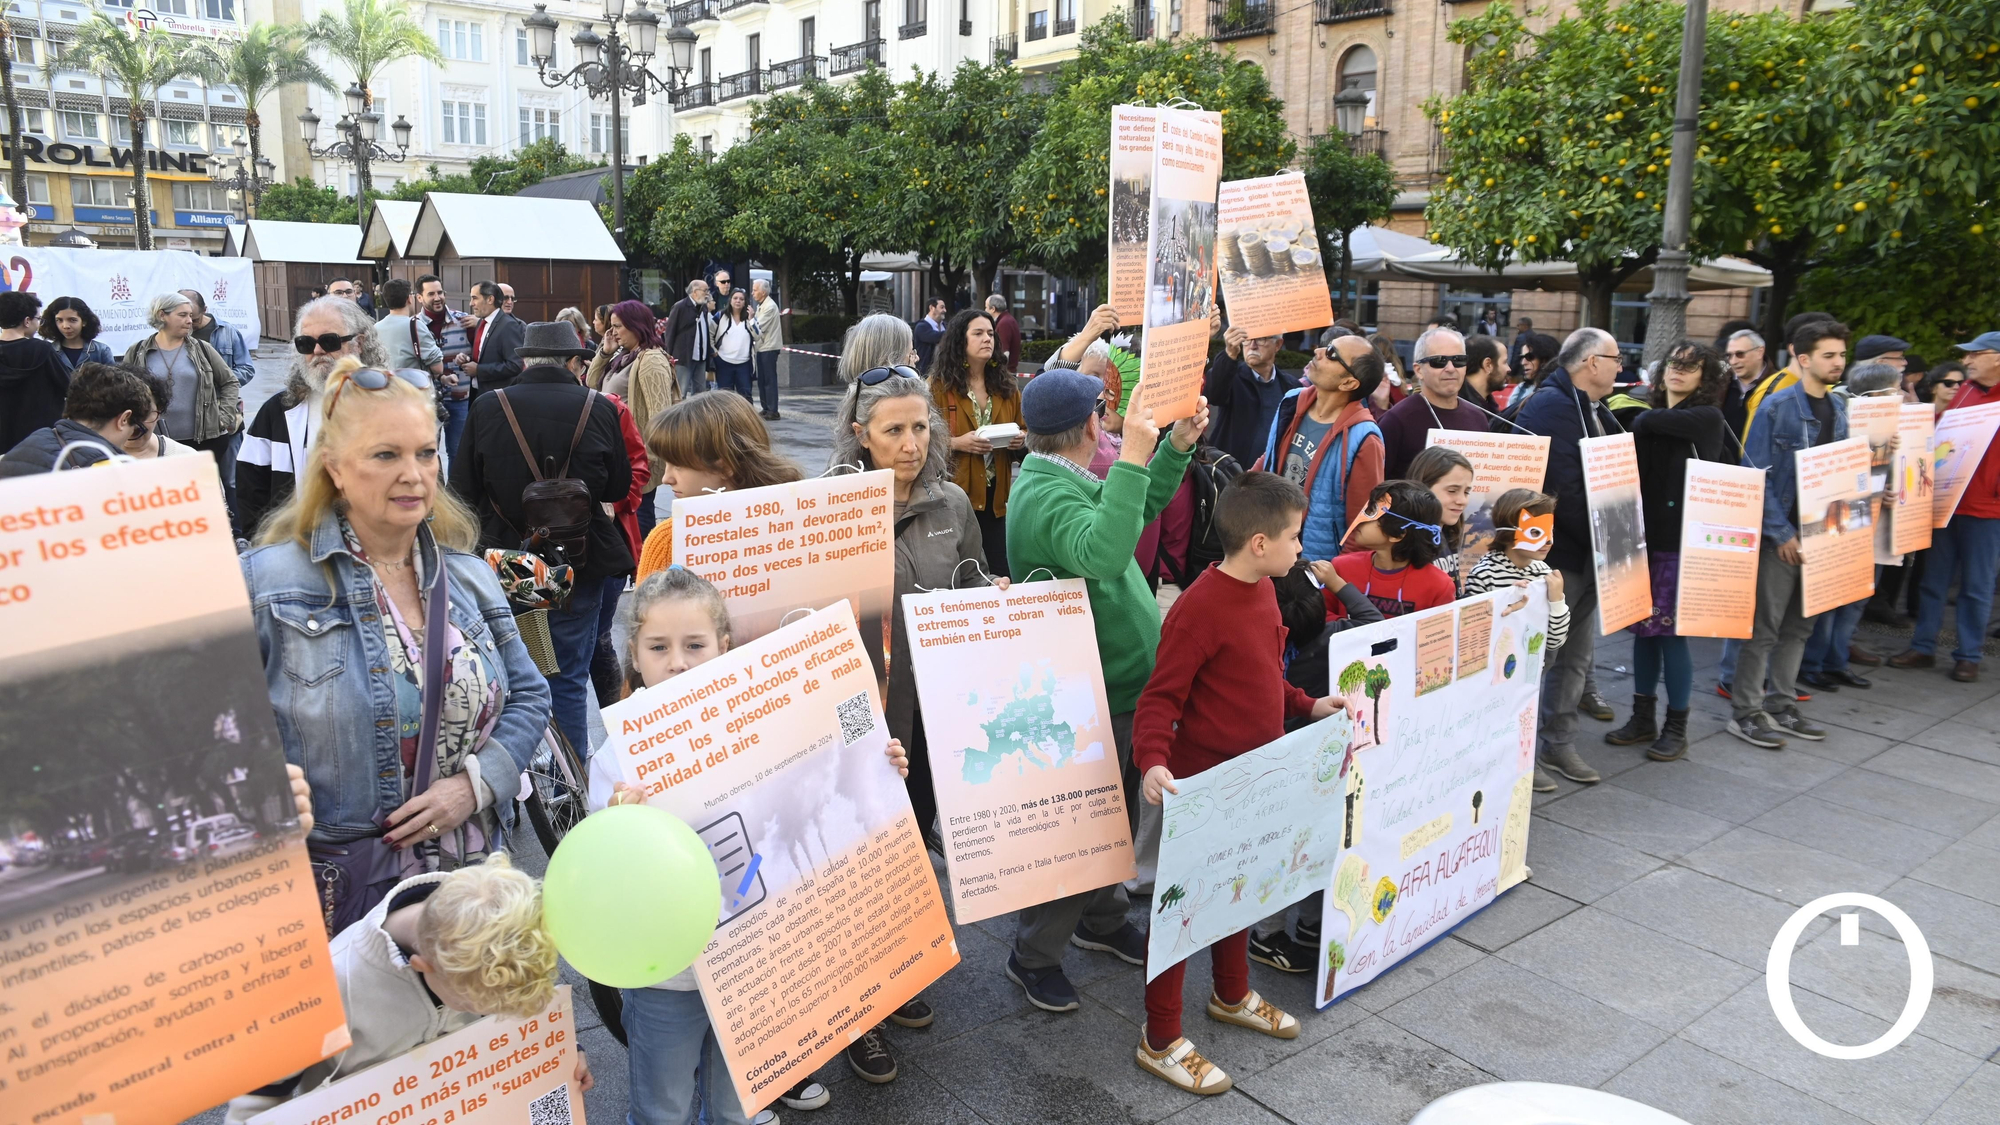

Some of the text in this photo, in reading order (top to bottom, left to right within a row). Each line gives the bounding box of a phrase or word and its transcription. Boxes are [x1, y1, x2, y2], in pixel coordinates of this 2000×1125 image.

[1119, 114, 1156, 122] Necesitamos
[1162, 122, 1169, 133] El
[1129, 144, 1153, 152] grandes
[1162, 139, 1174, 151] será
[1220, 189, 1292, 205] ingreso global futuro
[1276, 178, 1302, 187] reducirá
[190, 214, 223, 224] Allianz
[94, 308, 128, 320] TAMIENTO
[1433, 437, 1445, 445] Las
[1448, 438, 1496, 448] subvenciones
[1464, 450, 1488, 459] carbón
[1508, 453, 1532, 461] crecido
[1483, 463, 1511, 471] Acuerdo
[1509, 476, 1539, 484] climático
[0, 481, 201, 533] estra ciudad
[685, 485, 887, 527] Desde 1980, los incendios
[1472, 485, 1490, 493] 2015
[38, 517, 209, 562] los efectos
[685, 504, 886, 547] forestales han devorado en
[686, 549, 738, 567] Europa
[743, 545, 772, 557] mas
[777, 538, 794, 551] de
[799, 527, 853, 547] 190.000
[733, 538, 887, 578] dos veces la superficie
[719, 578, 770, 599] ortugal
[914, 589, 1083, 616] Los fenómenos metereológicos
[917, 604, 1086, 632] extremos se cobran vidas,
[919, 625, 1022, 648] también en Europa
[621, 671, 737, 736] Ayuntamientos
[743, 664, 754, 680] y
[628, 637, 855, 756] carecen de protocolos eficaces
[635, 656, 862, 780] para los episodios de mala
[646, 731, 760, 798] calidad del aire
[704, 733, 833, 810] Mundo obrero, 10 de septiembre de 2024
[1021, 782, 1118, 811] más de 138.000 personas
[951, 796, 1107, 840] perdieron vida culpa
[953, 806, 1122, 850] fenómenos metereológicos climáticos
[101, 839, 285, 908] urgente de plantación
[959, 851, 1077, 887] Alemania, Francia Italia fueron
[1397, 861, 1430, 903] AFA
[55, 857, 289, 947] en los espacios urbanos sin
[706, 829, 913, 967] responsables cada año en España de 10.000 muertes
[1455, 886, 1467, 911] de
[101, 886, 280, 957] patios colegios
[930, 933, 946, 950] que
[64, 940, 244, 1017] dióxido de carbono
[183, 995, 322, 1061] contra el cambio
[746, 949, 924, 1082] Córdoba ciudades
[393, 1020, 539, 1097] de 2024 es ya
[750, 1003, 875, 1095] desobedecen este mandato.
[420, 1045, 539, 1111] más muertes
[460, 1049, 566, 1116] las "suaves"
